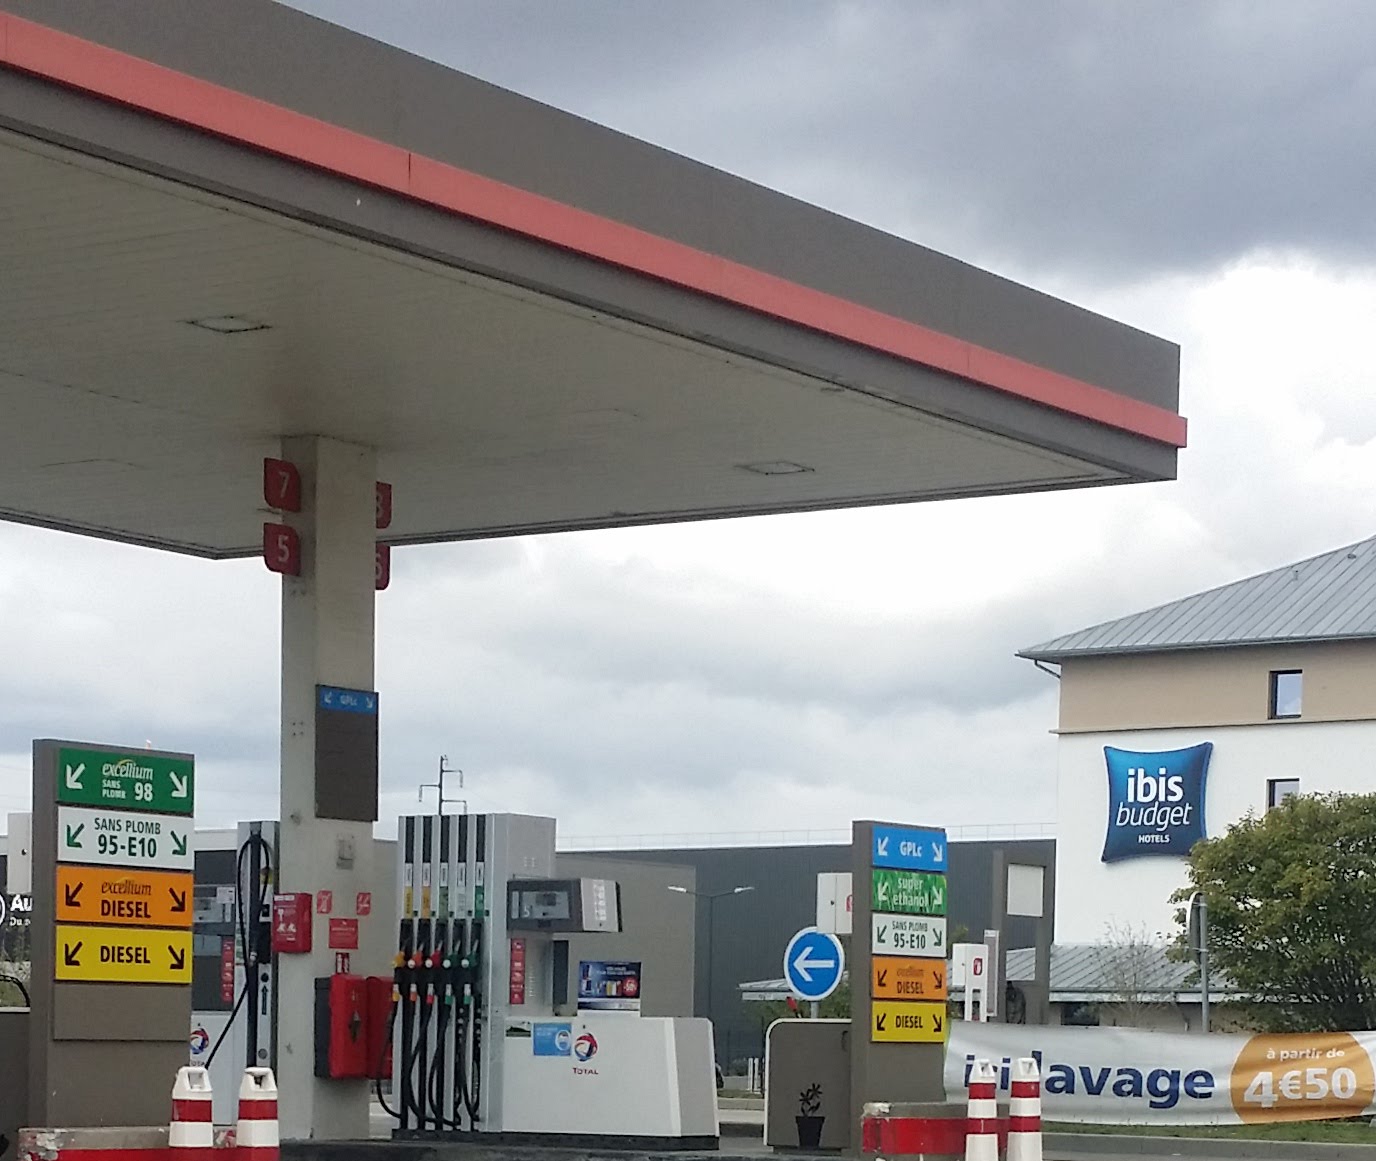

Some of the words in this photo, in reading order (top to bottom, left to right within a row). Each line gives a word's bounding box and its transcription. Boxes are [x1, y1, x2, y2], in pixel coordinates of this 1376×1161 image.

[279, 471, 289, 499] 7
[277, 535, 290, 563] 5
[102, 759, 154, 781] excellium
[102, 779, 121, 790] SANS
[134, 782, 153, 802] 98
[1127, 767, 1184, 803] ibis
[1116, 801, 1193, 832] budget
[94, 817, 122, 832] SANS
[125, 820, 161, 835] PLOMB
[98, 833, 157, 858] 95-E10
[1138, 834, 1170, 844] HOTELS
[900, 841, 923, 858] GPLc
[101, 880, 152, 895] excellium
[898, 877, 924, 893] super
[893, 892, 929, 908] ethanol
[101, 899, 152, 919] DIESEL
[892, 920, 907, 931] SANS
[894, 932, 926, 949] 95-E10
[100, 945, 151, 964] DIESEL
[897, 981, 925, 994] DIESEL
[895, 1015, 923, 1029] DIESEL
[1267, 1047, 1275, 1059] à
[1280, 1048, 1323, 1062] partir
[1326, 1047, 1345, 1059] de
[573, 1067, 599, 1076] TOTAL
[964, 1054, 1011, 1091] ii
[1243, 1067, 1357, 1108] 4€50
